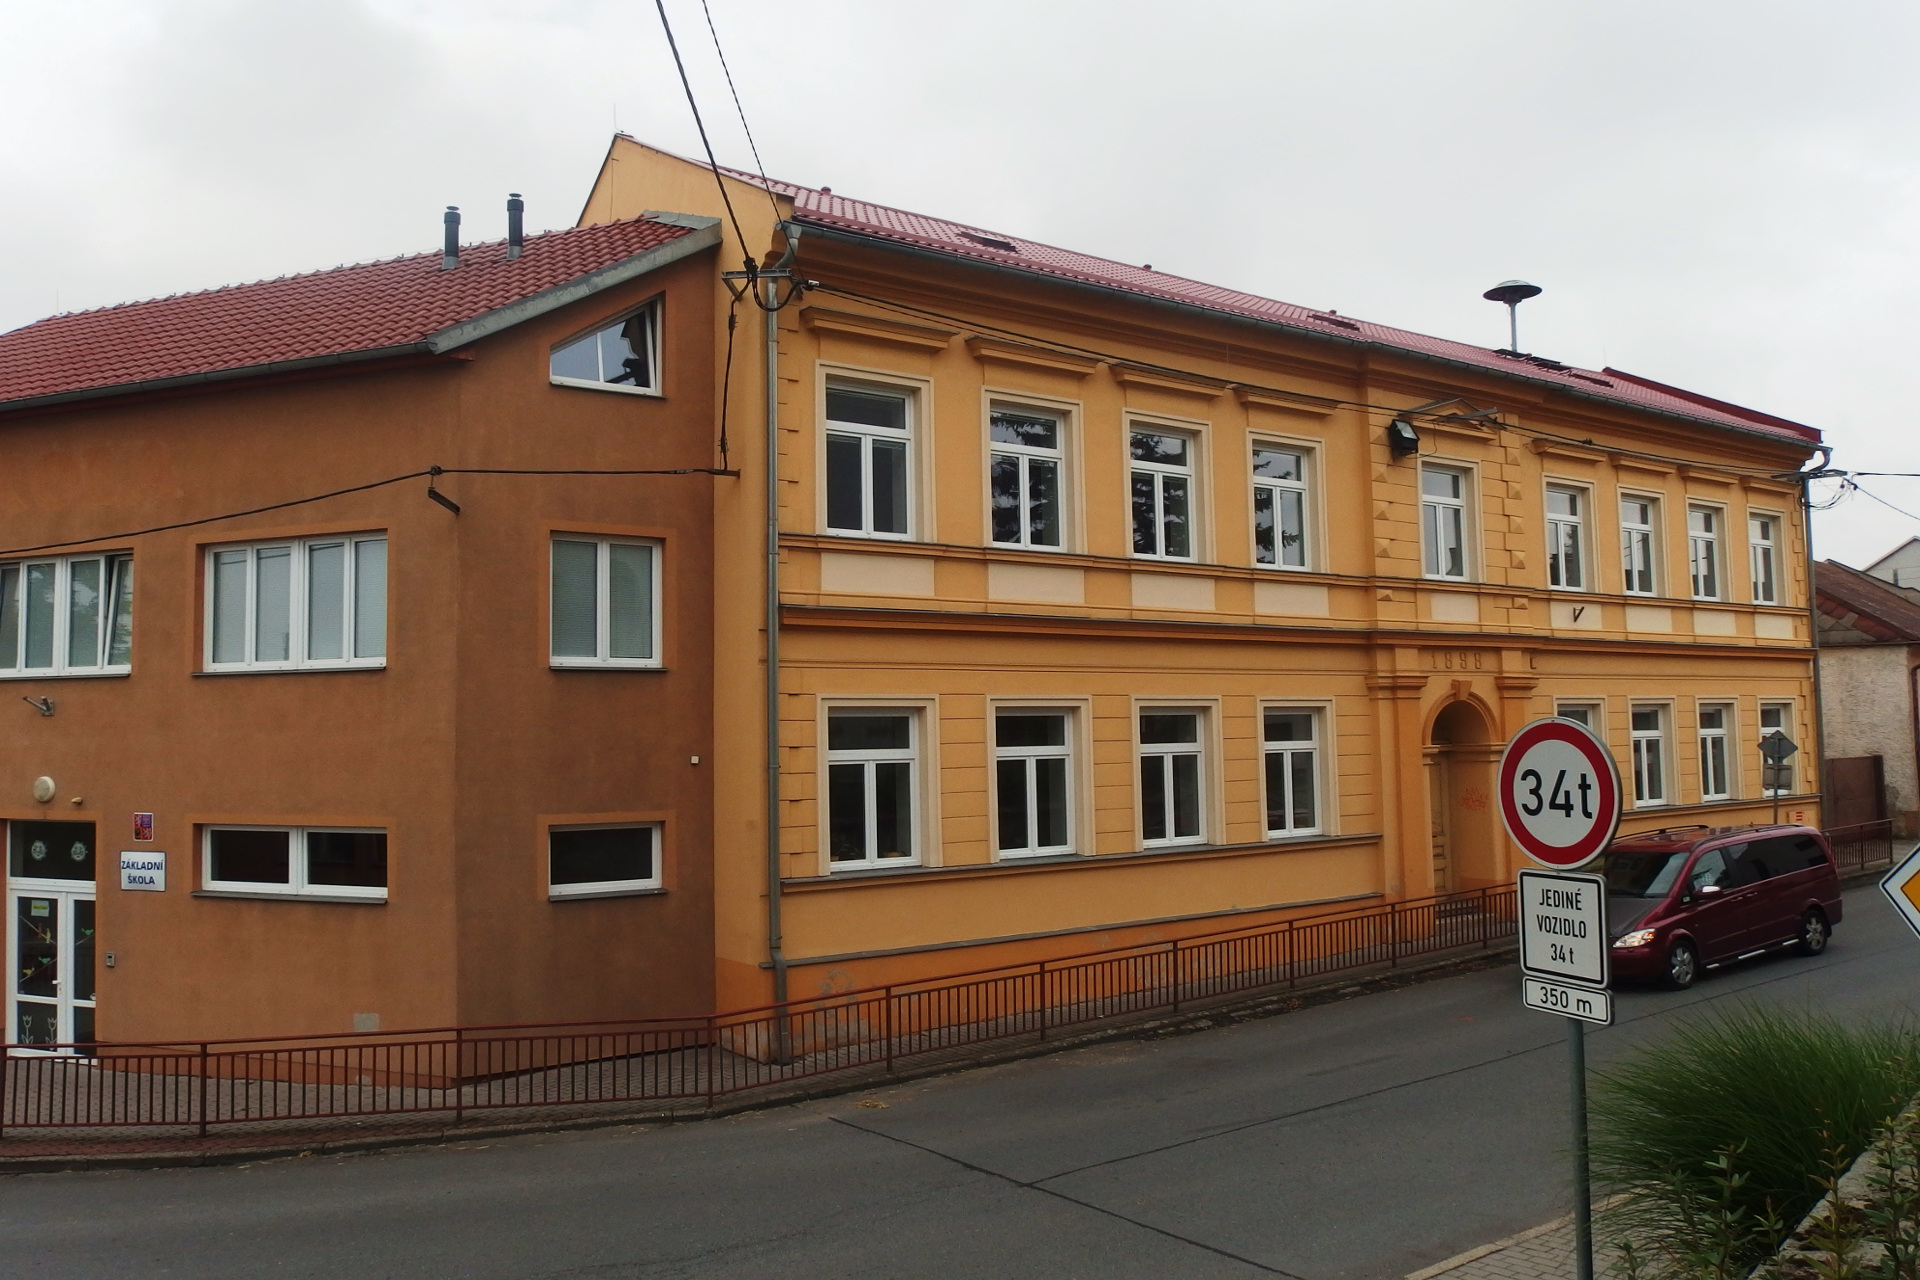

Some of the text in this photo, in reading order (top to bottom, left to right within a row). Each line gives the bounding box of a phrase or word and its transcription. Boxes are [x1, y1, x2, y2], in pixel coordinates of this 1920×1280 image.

[1431, 651, 1482, 669] 1898
[1520, 768, 1593, 819] 34t
[121, 859, 164, 870] ZÁKLADNÍ
[127, 873, 155, 884] ŠKOLA
[1539, 888, 1582, 910] JEDINÉ
[1536, 914, 1586, 938] VOZIDLO
[1540, 986, 1592, 1014] 350 m
